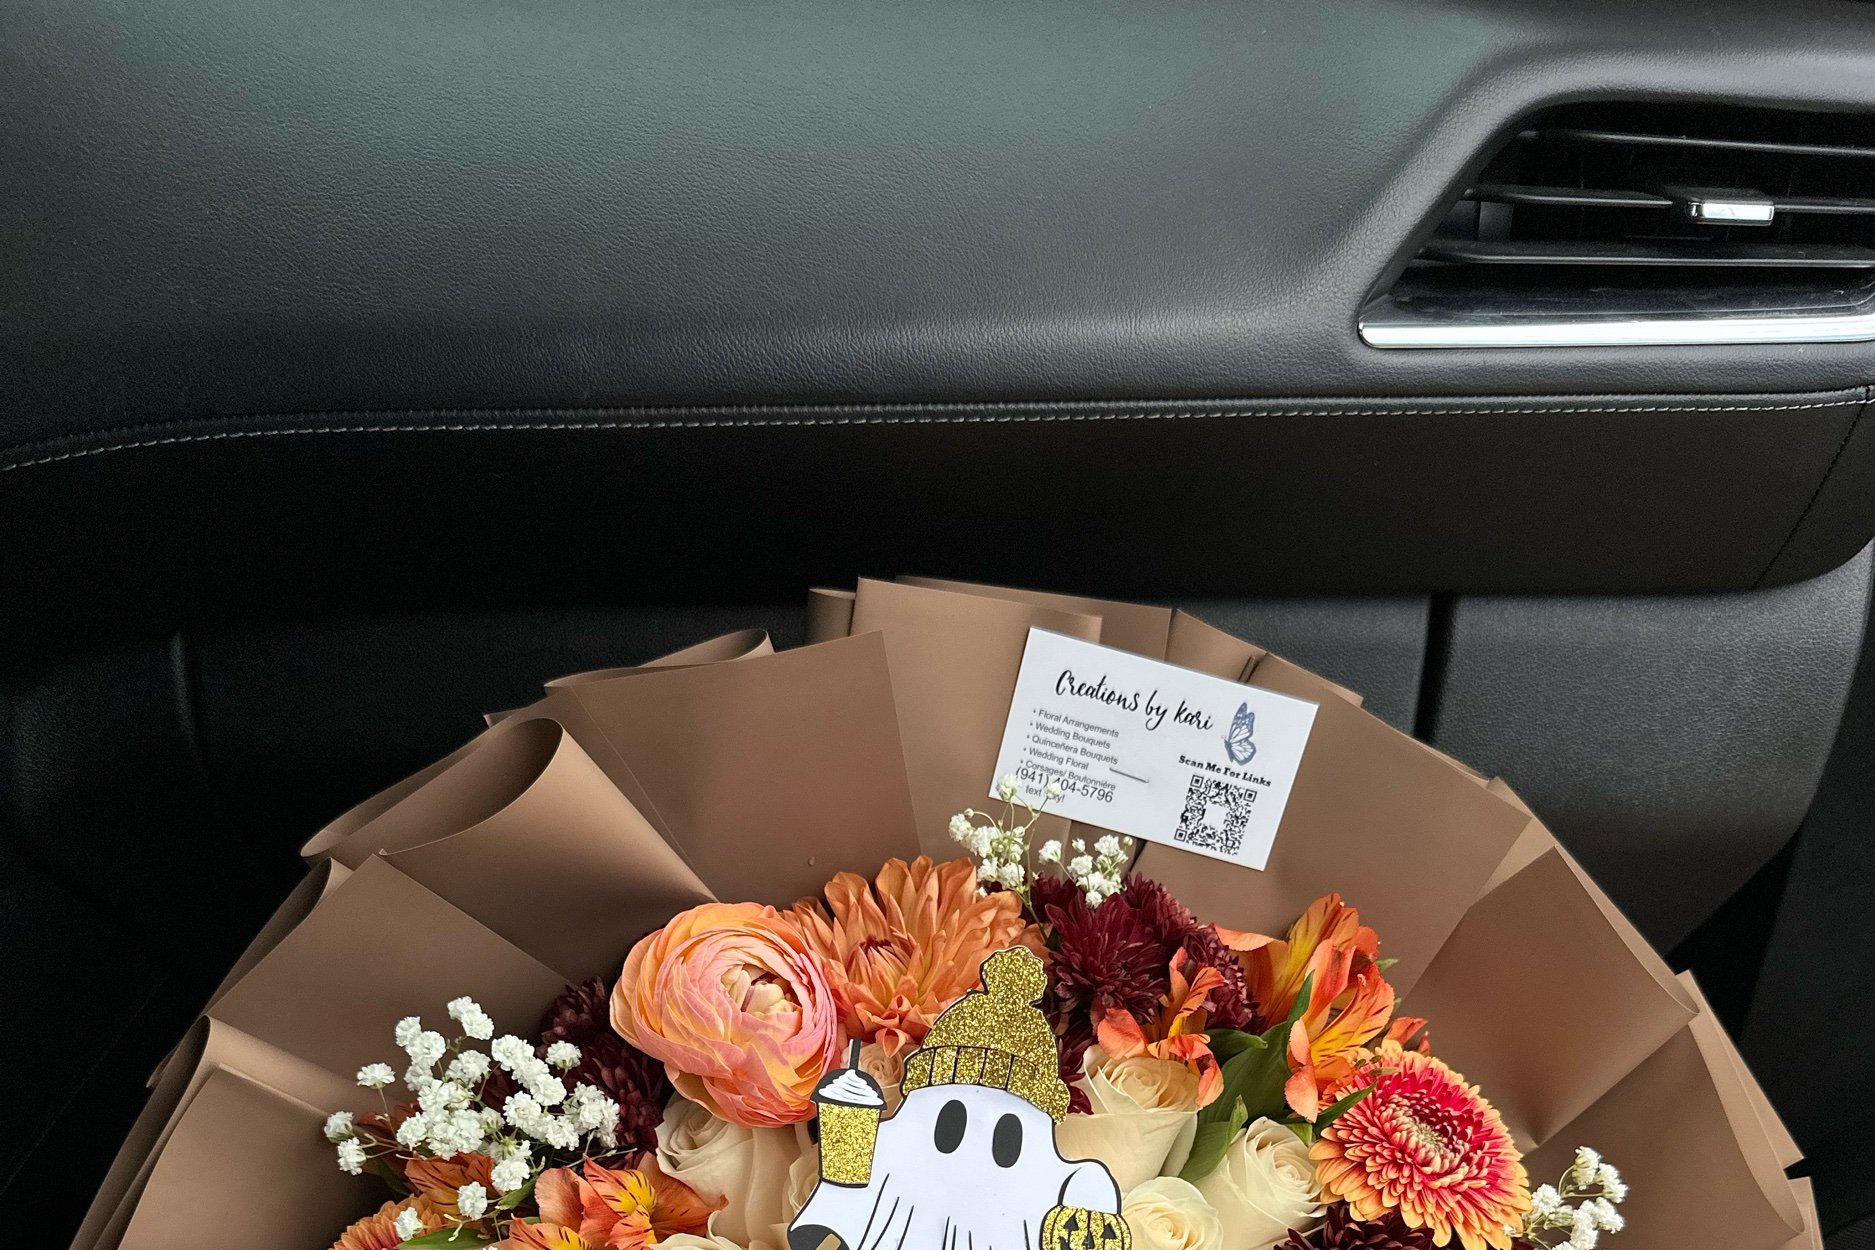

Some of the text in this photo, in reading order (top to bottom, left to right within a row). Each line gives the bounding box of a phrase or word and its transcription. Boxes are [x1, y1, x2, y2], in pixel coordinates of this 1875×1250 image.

[1055, 670, 1140, 711] Creations
[1145, 690, 1168, 731] by
[1035, 721, 1111, 749] Wedding Bouquets
[1038, 709, 1119, 738] Floral Arrangements
[1029, 747, 1089, 770] Wedding Floral
[1079, 747, 1119, 765] Bouquets
[1015, 766, 1050, 788] (941)
[1178, 755, 1272, 788] Scan Me For Links
[1025, 785, 1043, 798] text
